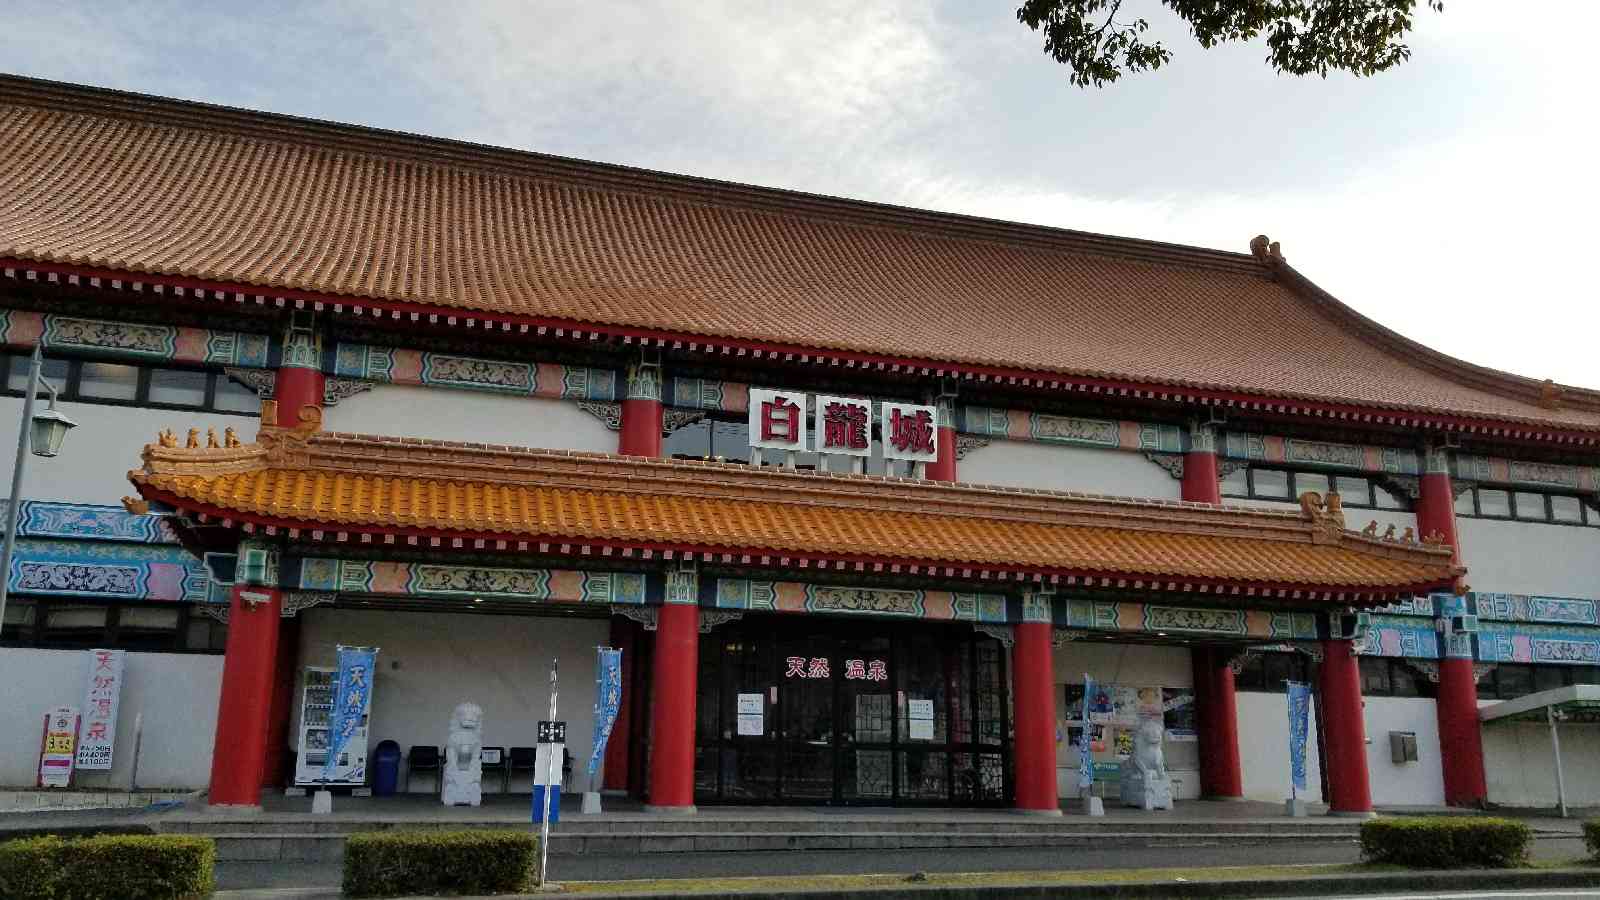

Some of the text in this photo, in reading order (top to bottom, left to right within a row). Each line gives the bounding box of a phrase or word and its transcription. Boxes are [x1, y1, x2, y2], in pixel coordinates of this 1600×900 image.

[760, 396, 936, 455] 白龍城
[87, 650, 115, 742] 天然温泉
[786, 656, 888, 682] 天然 温泉
